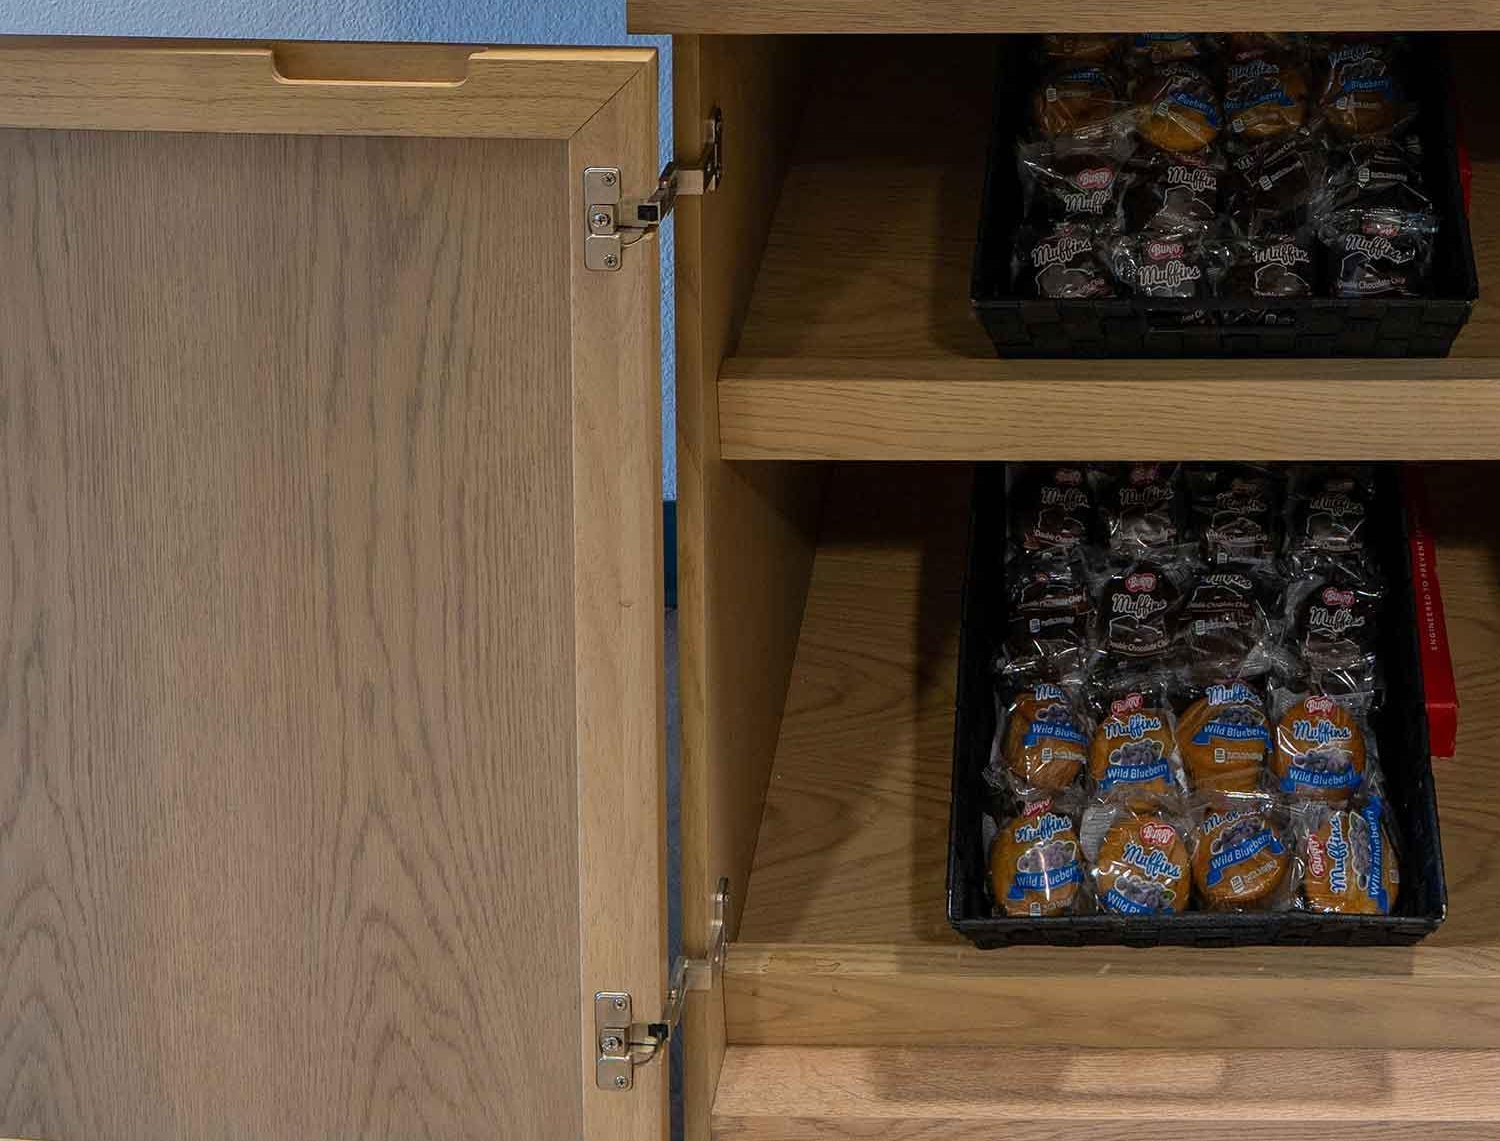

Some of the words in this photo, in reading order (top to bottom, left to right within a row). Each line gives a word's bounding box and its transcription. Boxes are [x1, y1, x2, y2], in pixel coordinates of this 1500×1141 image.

[1032, 236, 1092, 267] Muffins
[1138, 260, 1201, 287] Muffins
[1032, 724, 1053, 734] Wild
[1104, 714, 1161, 740] Muffins
[1204, 725, 1225, 736] Wild
[1292, 720, 1352, 744] Muffins
[1108, 768, 1129, 780] Wild
[1130, 764, 1168, 780] Blueberry
[1289, 769, 1311, 783] Wild
[1312, 771, 1354, 786] Blueberry
[1016, 813, 1072, 844] Muffins
[1124, 844, 1181, 878] Muffins
[1211, 853, 1234, 868] Wild
[1235, 833, 1275, 861] Blueberry
[1326, 814, 1348, 894] Muffins
[1016, 874, 1039, 887] Wild
[1108, 891, 1128, 913] Wild
